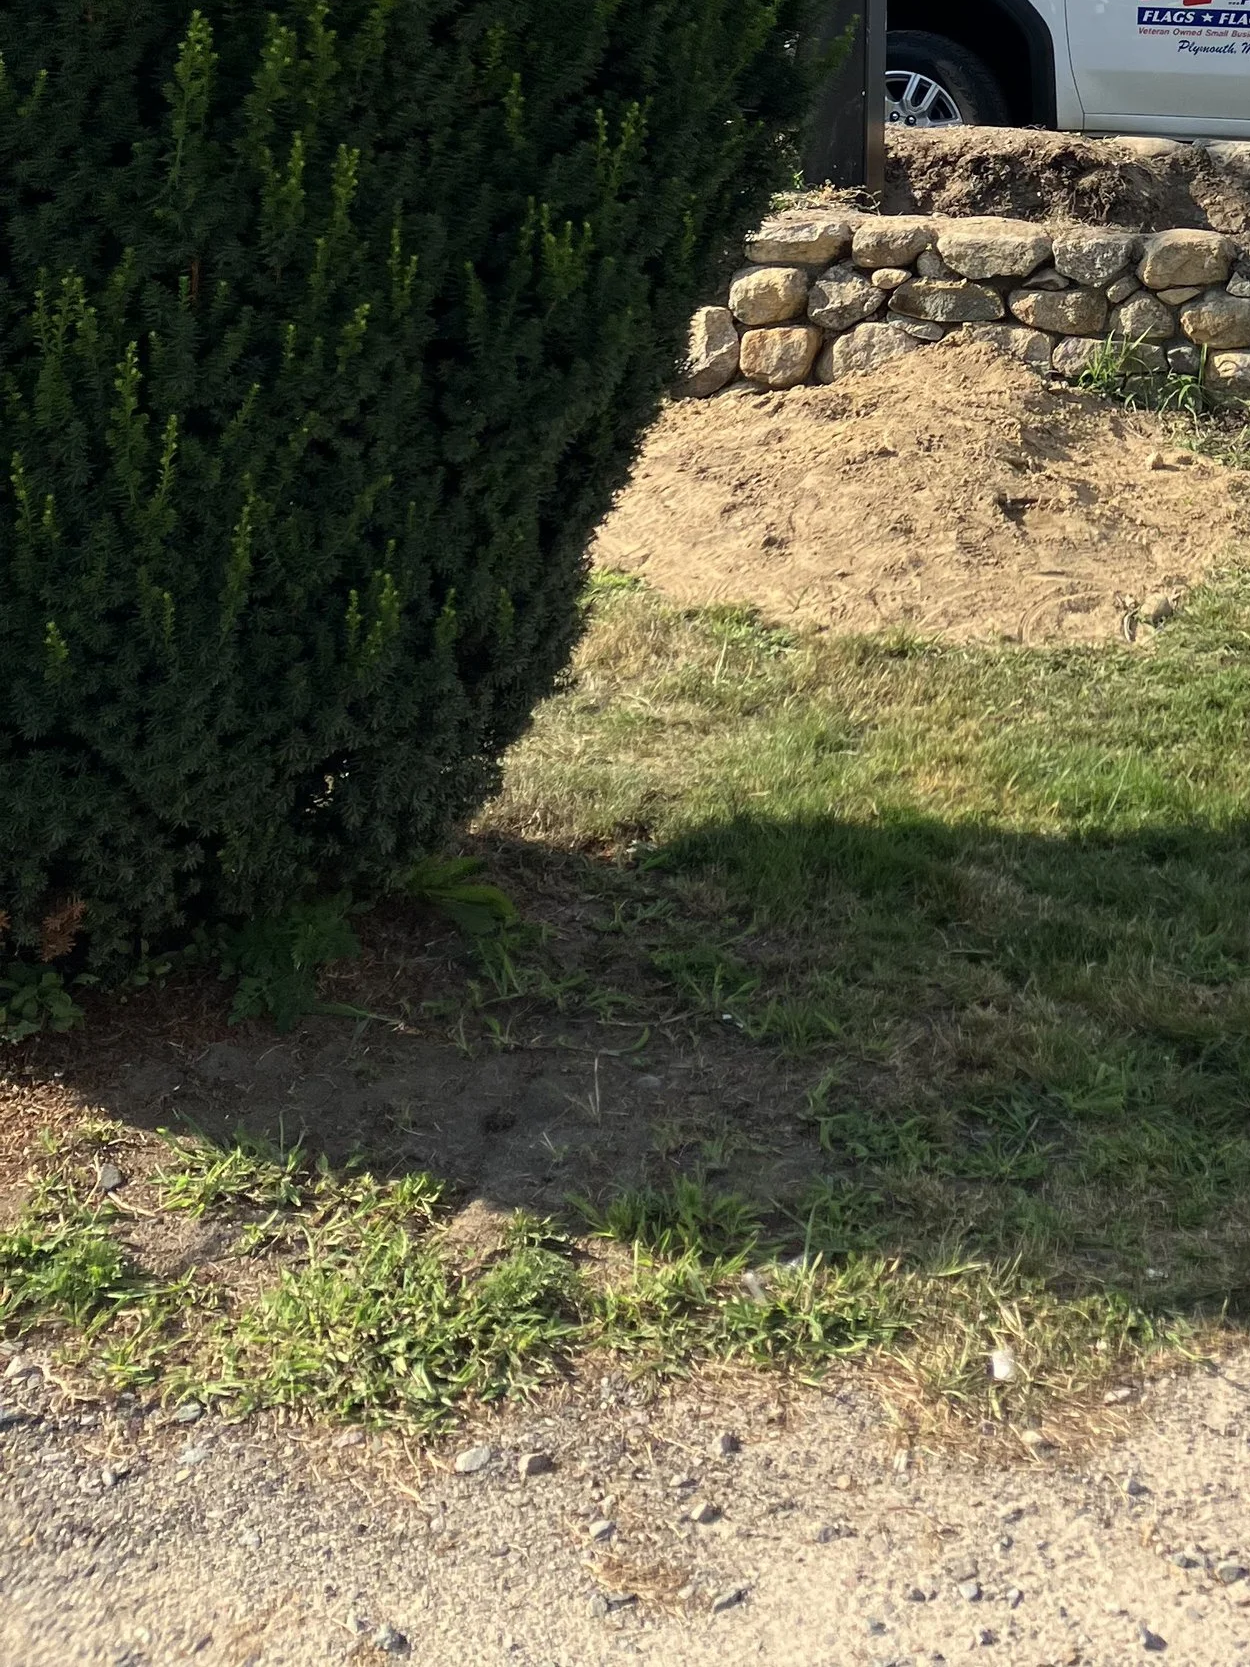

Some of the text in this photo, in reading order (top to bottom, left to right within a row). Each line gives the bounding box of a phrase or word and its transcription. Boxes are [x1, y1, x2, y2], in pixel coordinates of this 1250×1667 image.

[1142, 10, 1196, 24] FLAGS
[1138, 27, 1170, 36] Veteran
[1172, 28, 1202, 37] Owned
[1205, 29, 1229, 38] Small
